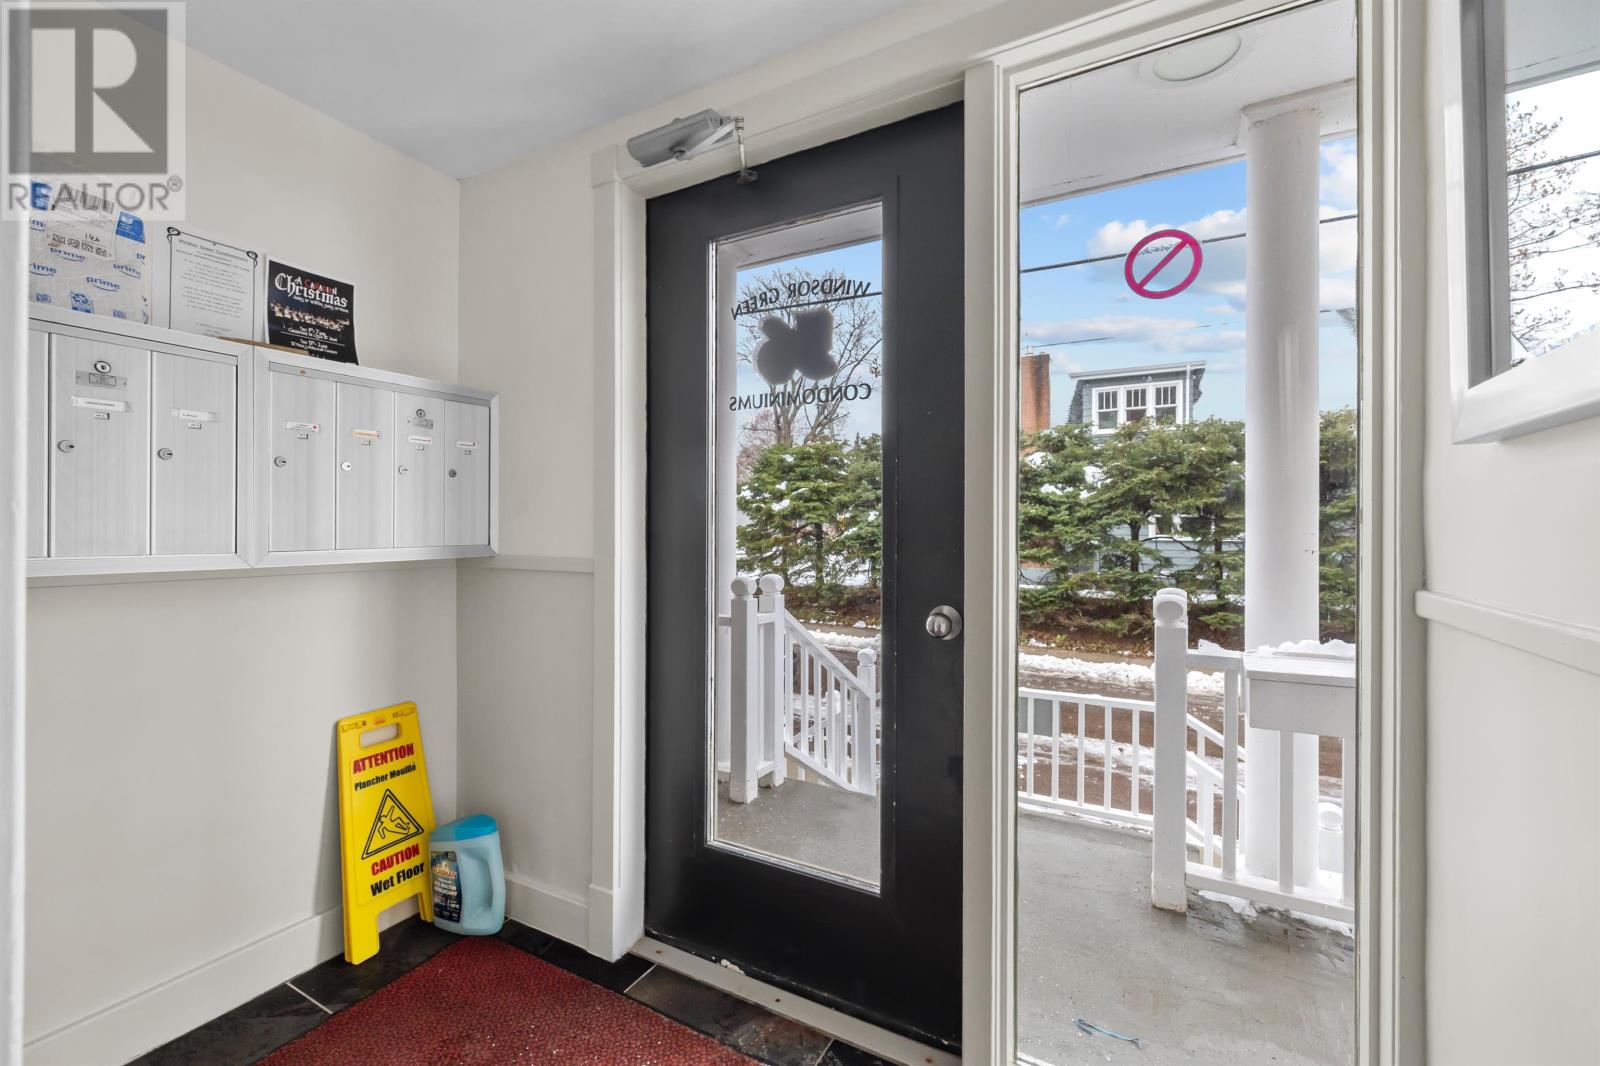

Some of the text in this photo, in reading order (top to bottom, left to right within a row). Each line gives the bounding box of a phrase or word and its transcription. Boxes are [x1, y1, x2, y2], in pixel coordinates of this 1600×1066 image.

[86, 276, 120, 290] prime
[274, 272, 348, 308] Christmas
[352, 742, 415, 774] ATTENTION
[354, 762, 417, 791] Plancher Mouillé
[371, 843, 420, 876] CAUTION
[370, 862, 425, 897] Wet Floor
